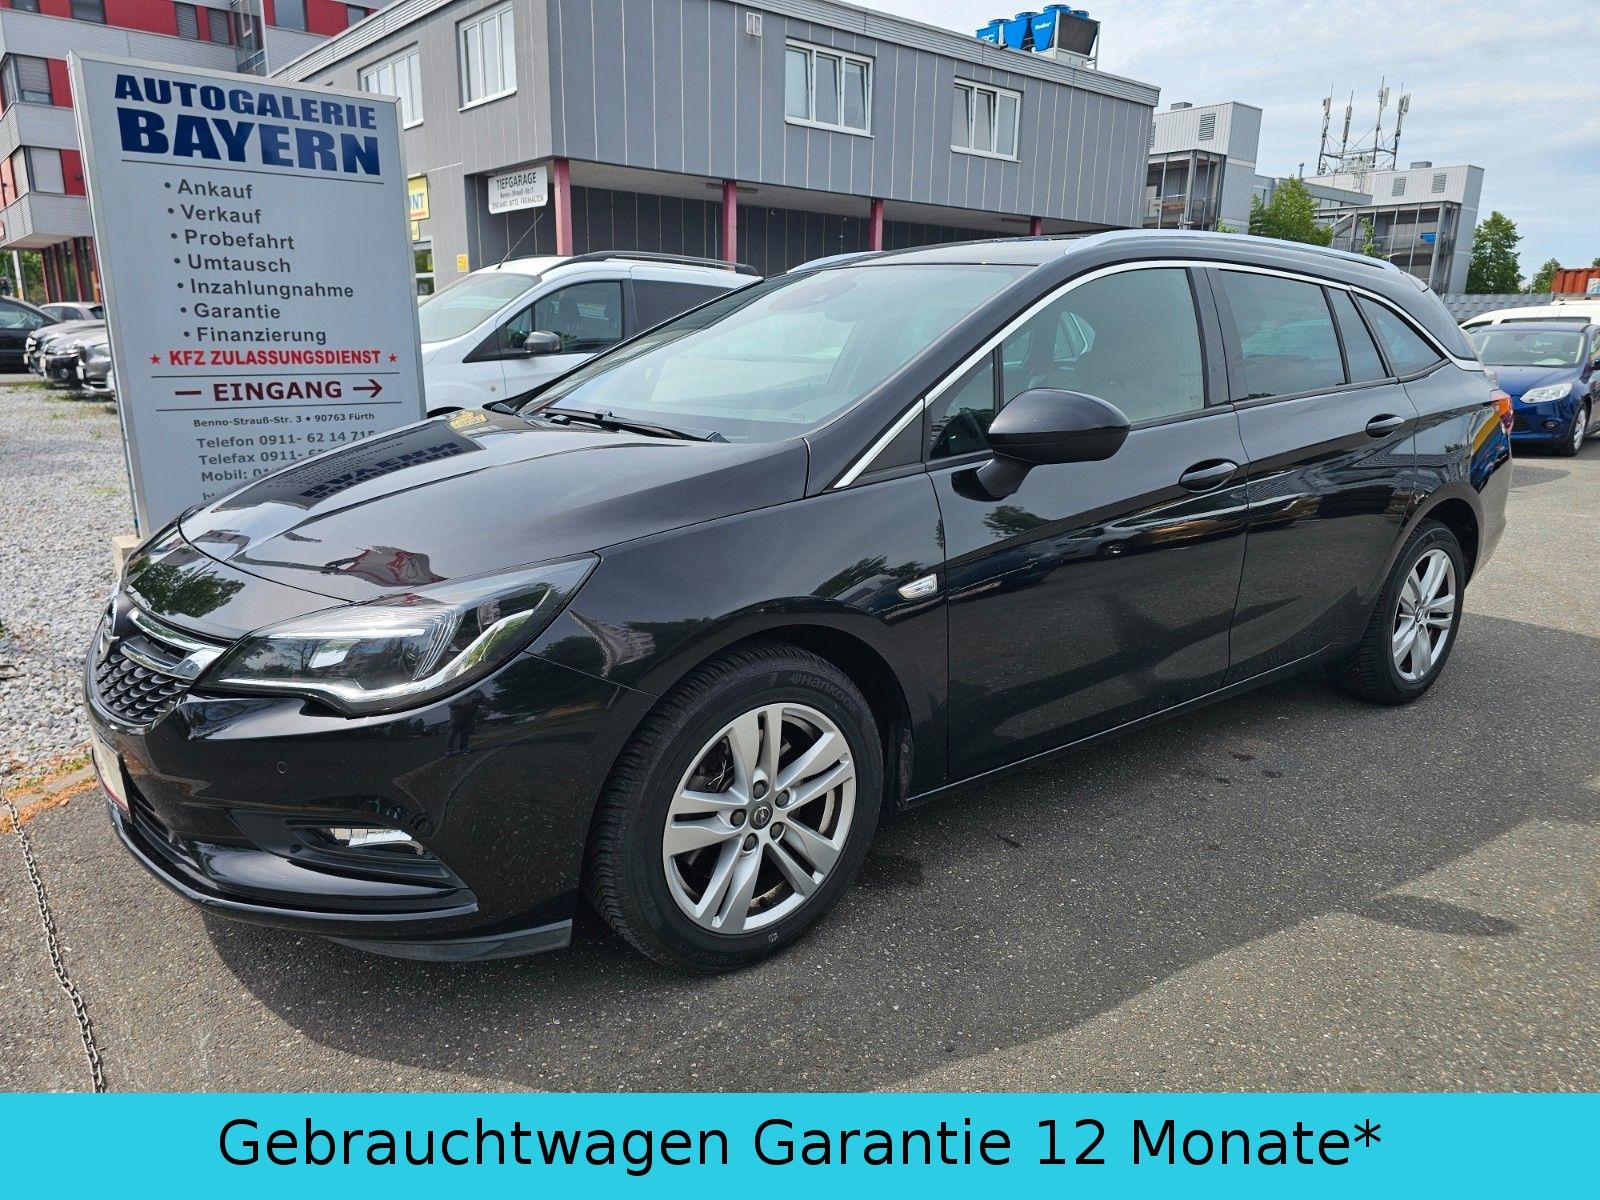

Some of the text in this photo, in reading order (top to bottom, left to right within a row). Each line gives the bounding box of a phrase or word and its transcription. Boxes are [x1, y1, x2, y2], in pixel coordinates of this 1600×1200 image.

[114, 74, 377, 130] AUTOGALERIE
[117, 107, 380, 176] BAYERN
[177, 178, 253, 200] Ankauf
[496, 171, 537, 190] TIEFGARAGE
[180, 203, 262, 225] Verkauf
[184, 228, 295, 251] Probefahrt
[187, 253, 291, 274] Umtausch
[190, 278, 354, 300] Inzahlungnahme
[193, 302, 281, 320] Garantie
[196, 326, 327, 346] Finanzierung
[168, 349, 382, 367] KFZ ZULASSUNGSDIENST
[212, 380, 343, 402] EINGANG
[193, 411, 376, 428] Benno-Strauß-Str. 3 90763 Fürth
[196, 435, 255, 450] Telefon
[259, 433, 303, 447] 0911-
[306, 432, 325, 444] 62
[329, 430, 347, 443] 14
[198, 452, 256, 467] Telefax
[260, 450, 304, 464] 0911-
[200, 468, 249, 483] Mobil:
